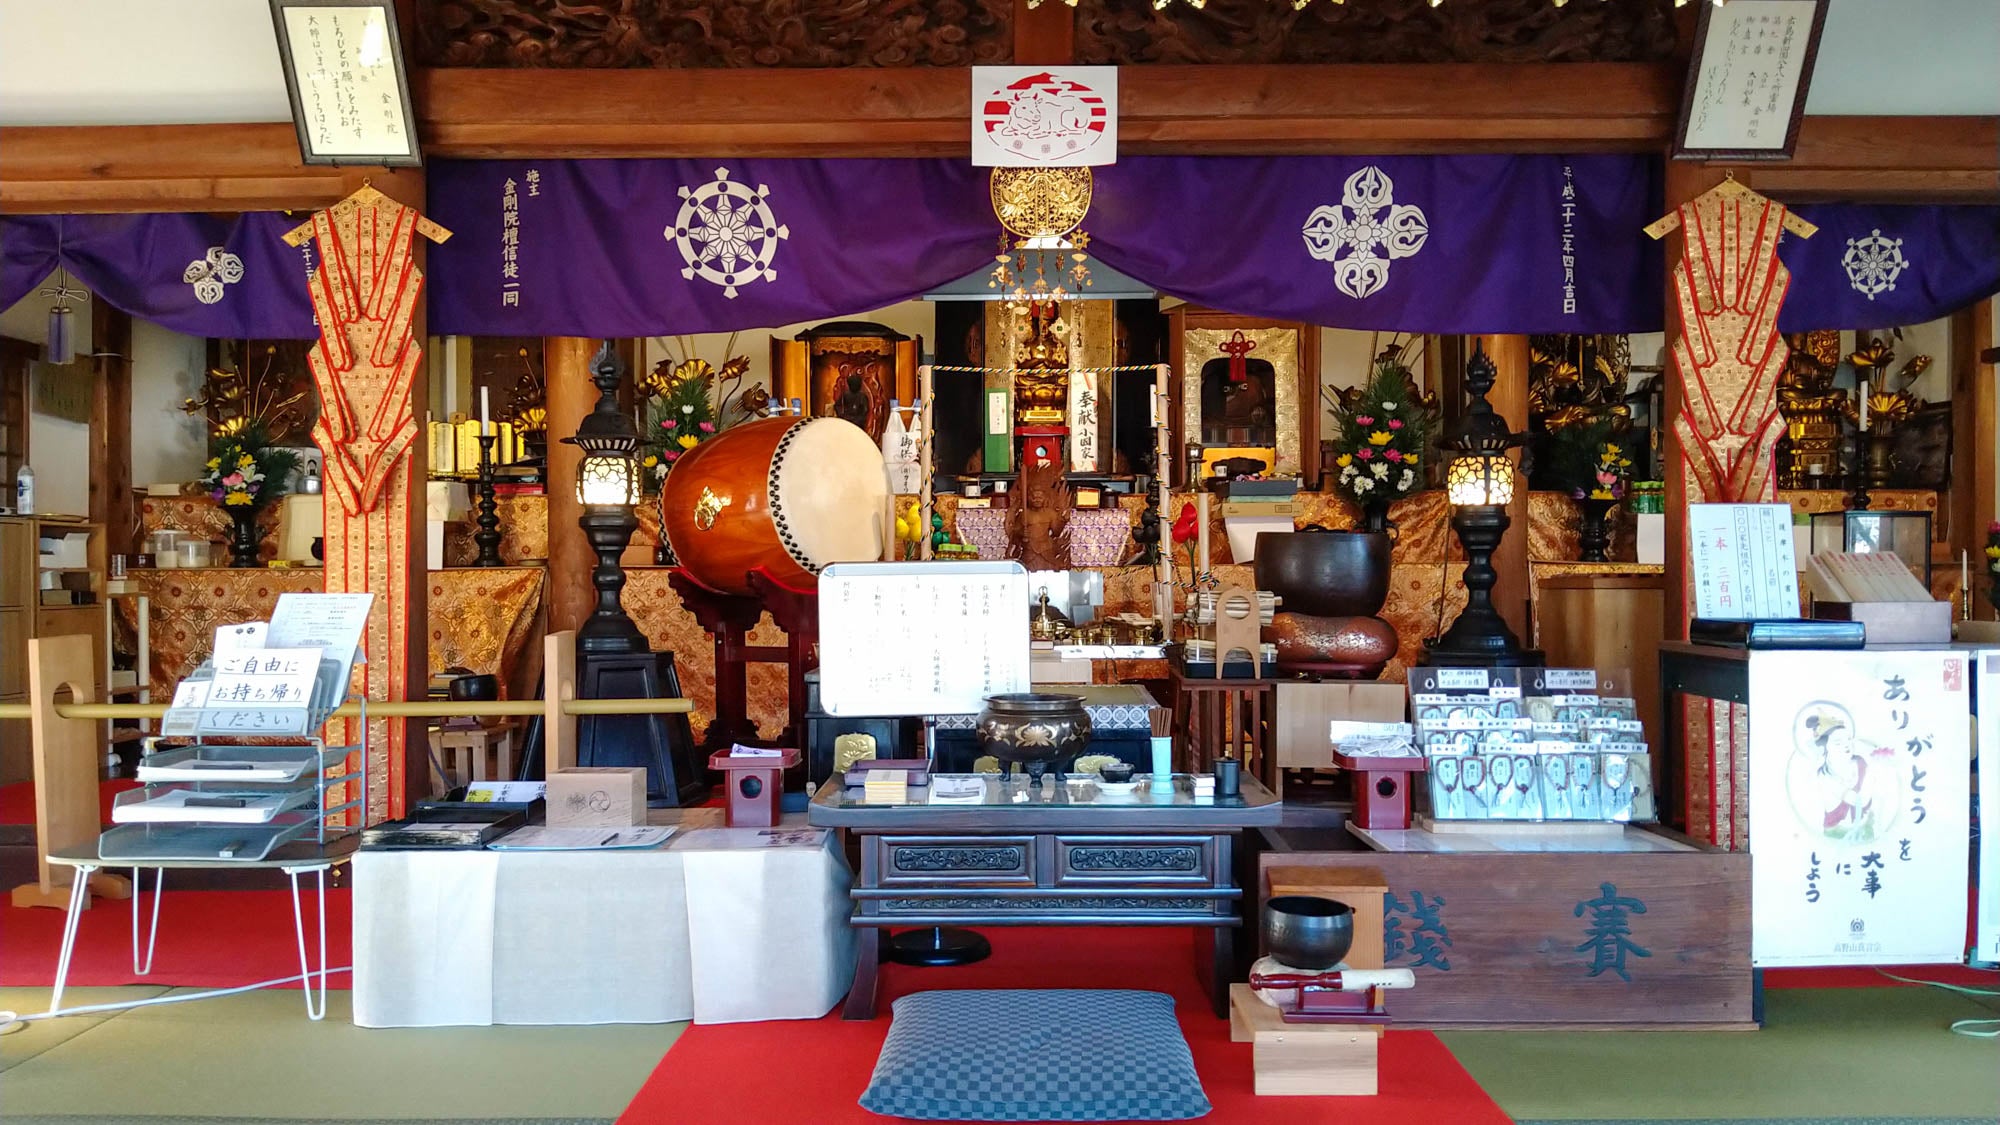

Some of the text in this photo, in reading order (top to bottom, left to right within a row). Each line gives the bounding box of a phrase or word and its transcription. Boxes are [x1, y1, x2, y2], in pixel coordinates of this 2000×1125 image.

[526, 169, 540, 197] 施主
[502, 178, 520, 307] 金剛院檀信徒一同
[1562, 166, 1576, 314] 平成二十三年四月吉日
[1712, 527, 1732, 608] 一本 三百円
[224, 656, 299, 674] ご自由に
[214, 683, 302, 702] お持ち帰り
[210, 711, 290, 728] ください
[1883, 674, 1934, 861] ありがとう を
[1836, 852, 1885, 899] 大事 に
